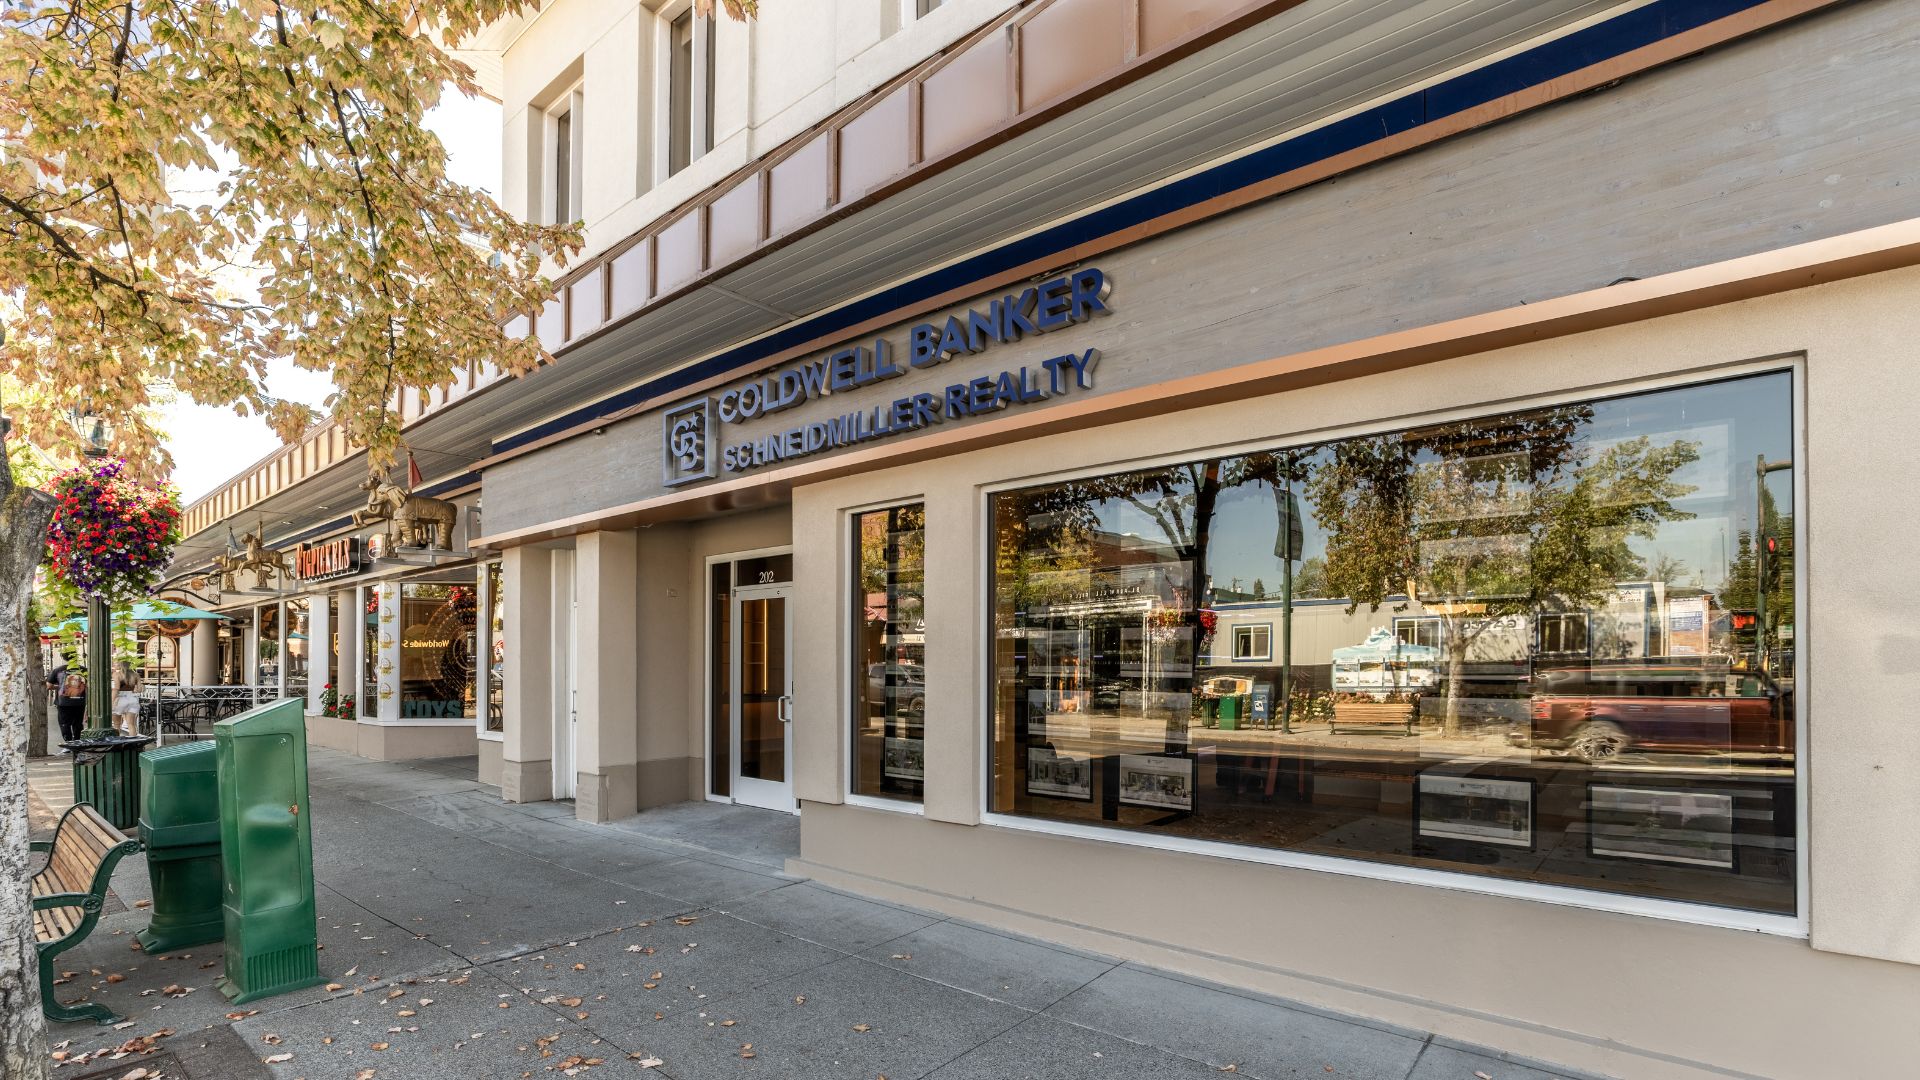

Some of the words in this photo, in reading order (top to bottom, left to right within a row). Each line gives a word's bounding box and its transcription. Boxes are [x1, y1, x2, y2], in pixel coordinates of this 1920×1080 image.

[718, 338, 904, 424] COLDWELL
[910, 267, 1112, 369] BANKER
[723, 392, 941, 472] SCHNEIDMILLER
[944, 348, 1100, 419] REALTY
[758, 571, 775, 584] 202
[404, 700, 462, 718] TOYS
